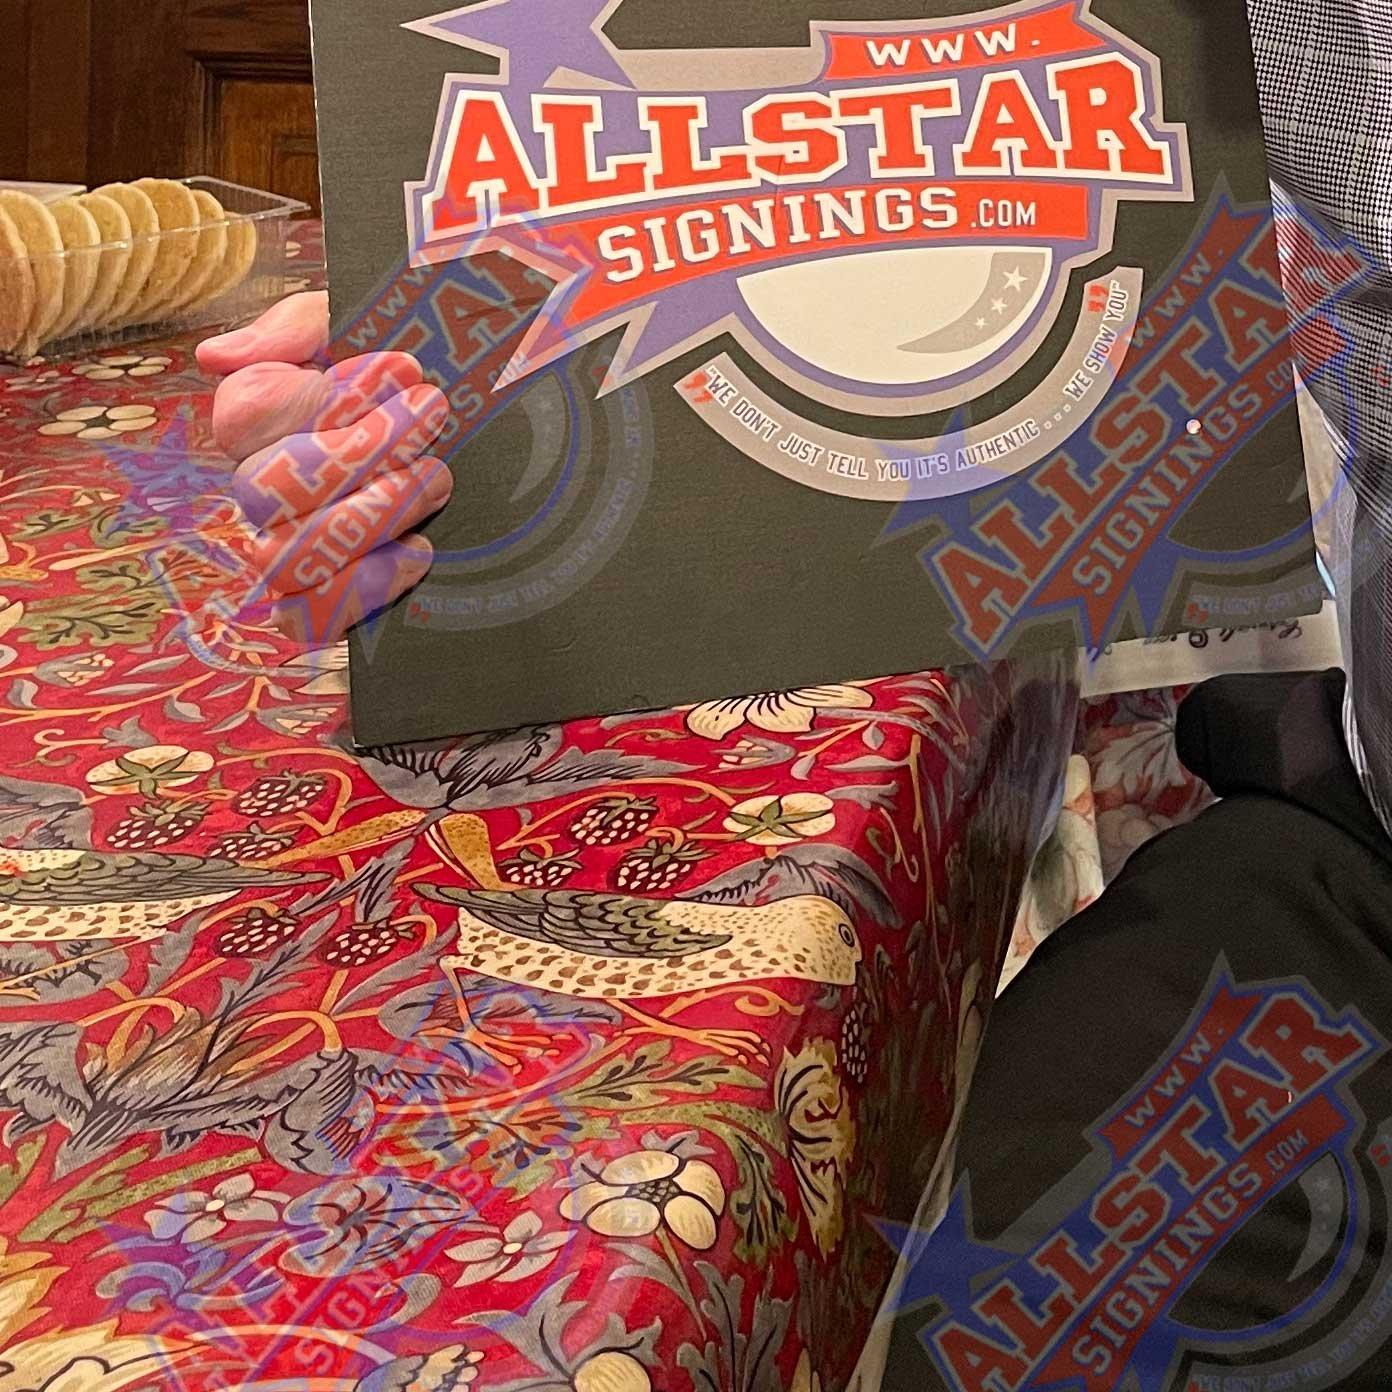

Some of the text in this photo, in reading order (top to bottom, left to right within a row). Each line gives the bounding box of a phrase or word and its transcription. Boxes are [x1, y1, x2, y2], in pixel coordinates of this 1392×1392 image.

[429, 51, 1174, 234] ALLSTAR
[596, 186, 1036, 284] SIGNINGS .COM
[731, 397, 781, 441] DON'T
[779, 433, 823, 466] JUST
[827, 451, 868, 479] TELL
[876, 459, 911, 481] YOU
[917, 454, 949, 478] IT'S
[956, 419, 1040, 471] AUTHENTIC
[1064, 370, 1093, 401] WE
[1084, 325, 1117, 373] SHOW
